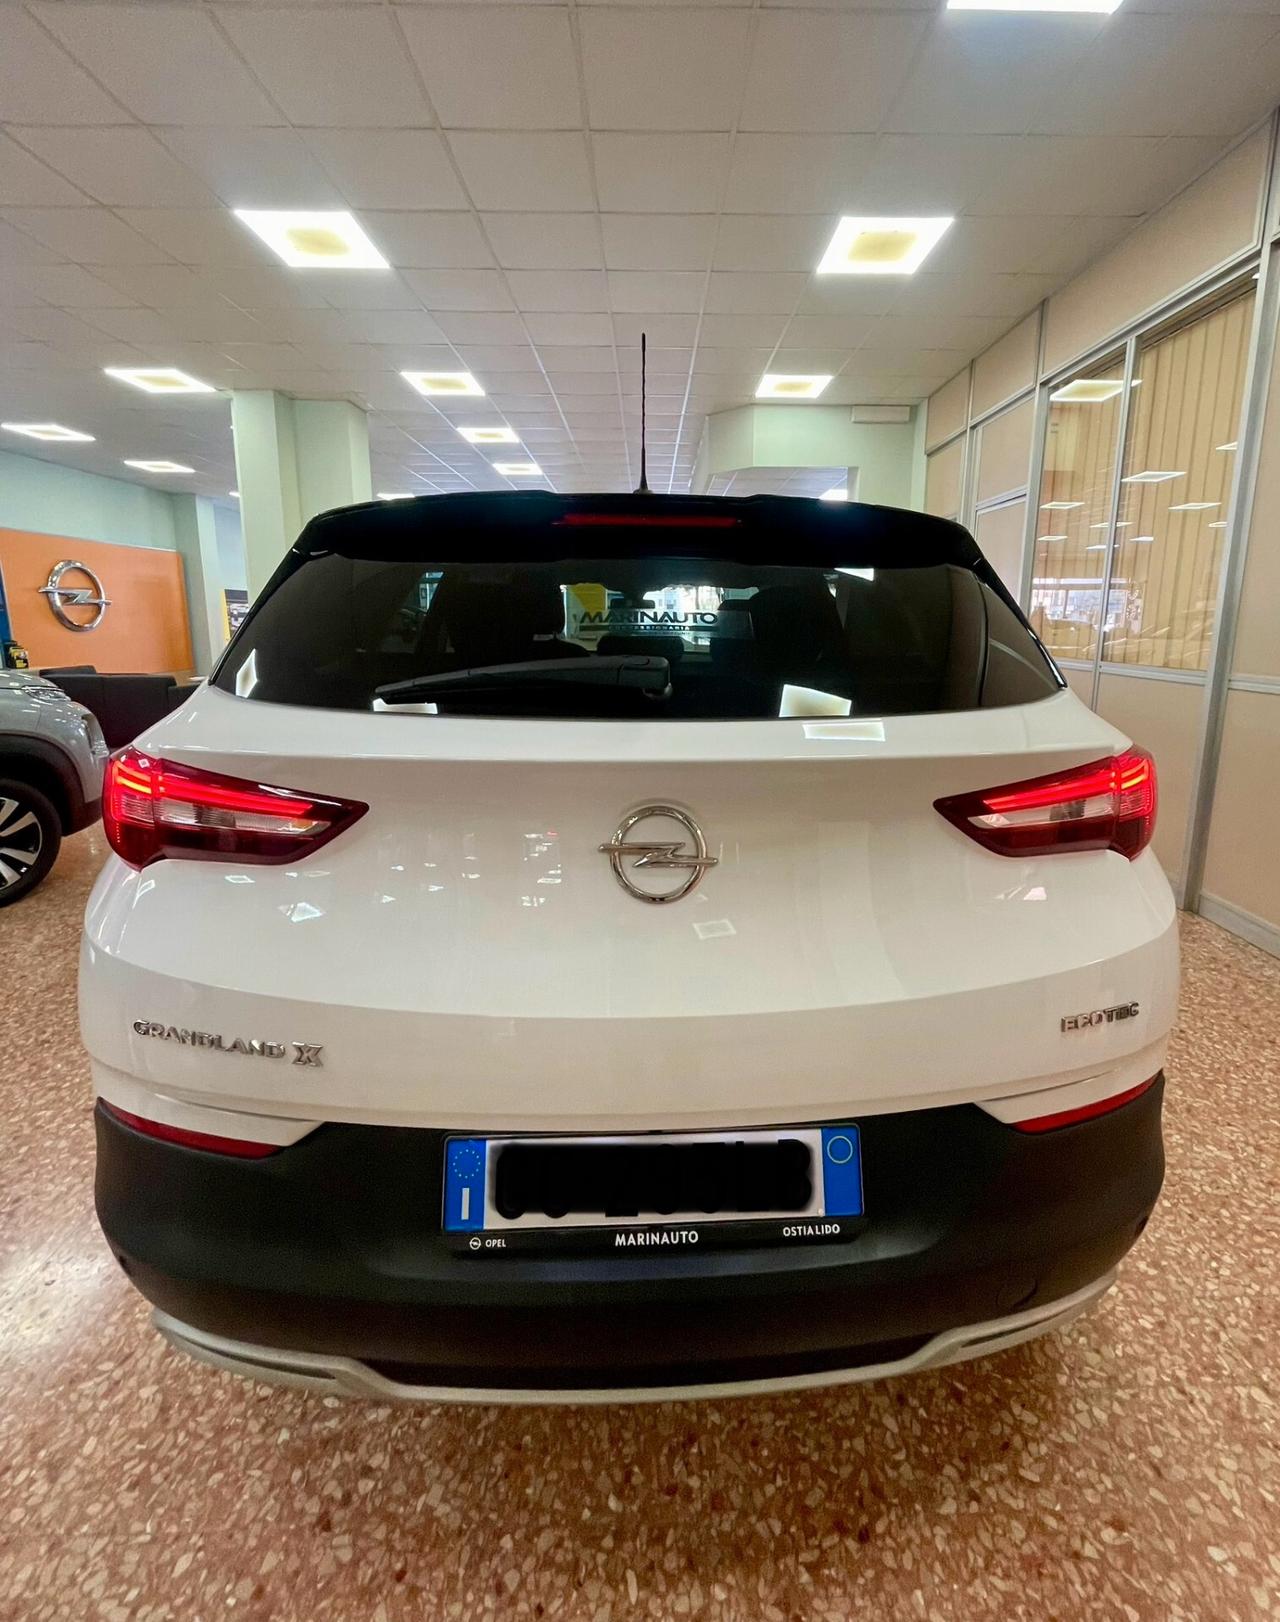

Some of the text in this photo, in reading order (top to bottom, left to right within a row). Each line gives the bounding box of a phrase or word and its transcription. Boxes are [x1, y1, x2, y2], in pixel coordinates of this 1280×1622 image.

[580, 611, 719, 624] MARINAUTO
[1060, 1001, 1139, 1033] ECOTEC
[133, 1019, 324, 1068] GRANDLAND X
[485, 1238, 507, 1248] OPEL
[615, 1230, 699, 1247] MARINAUTO
